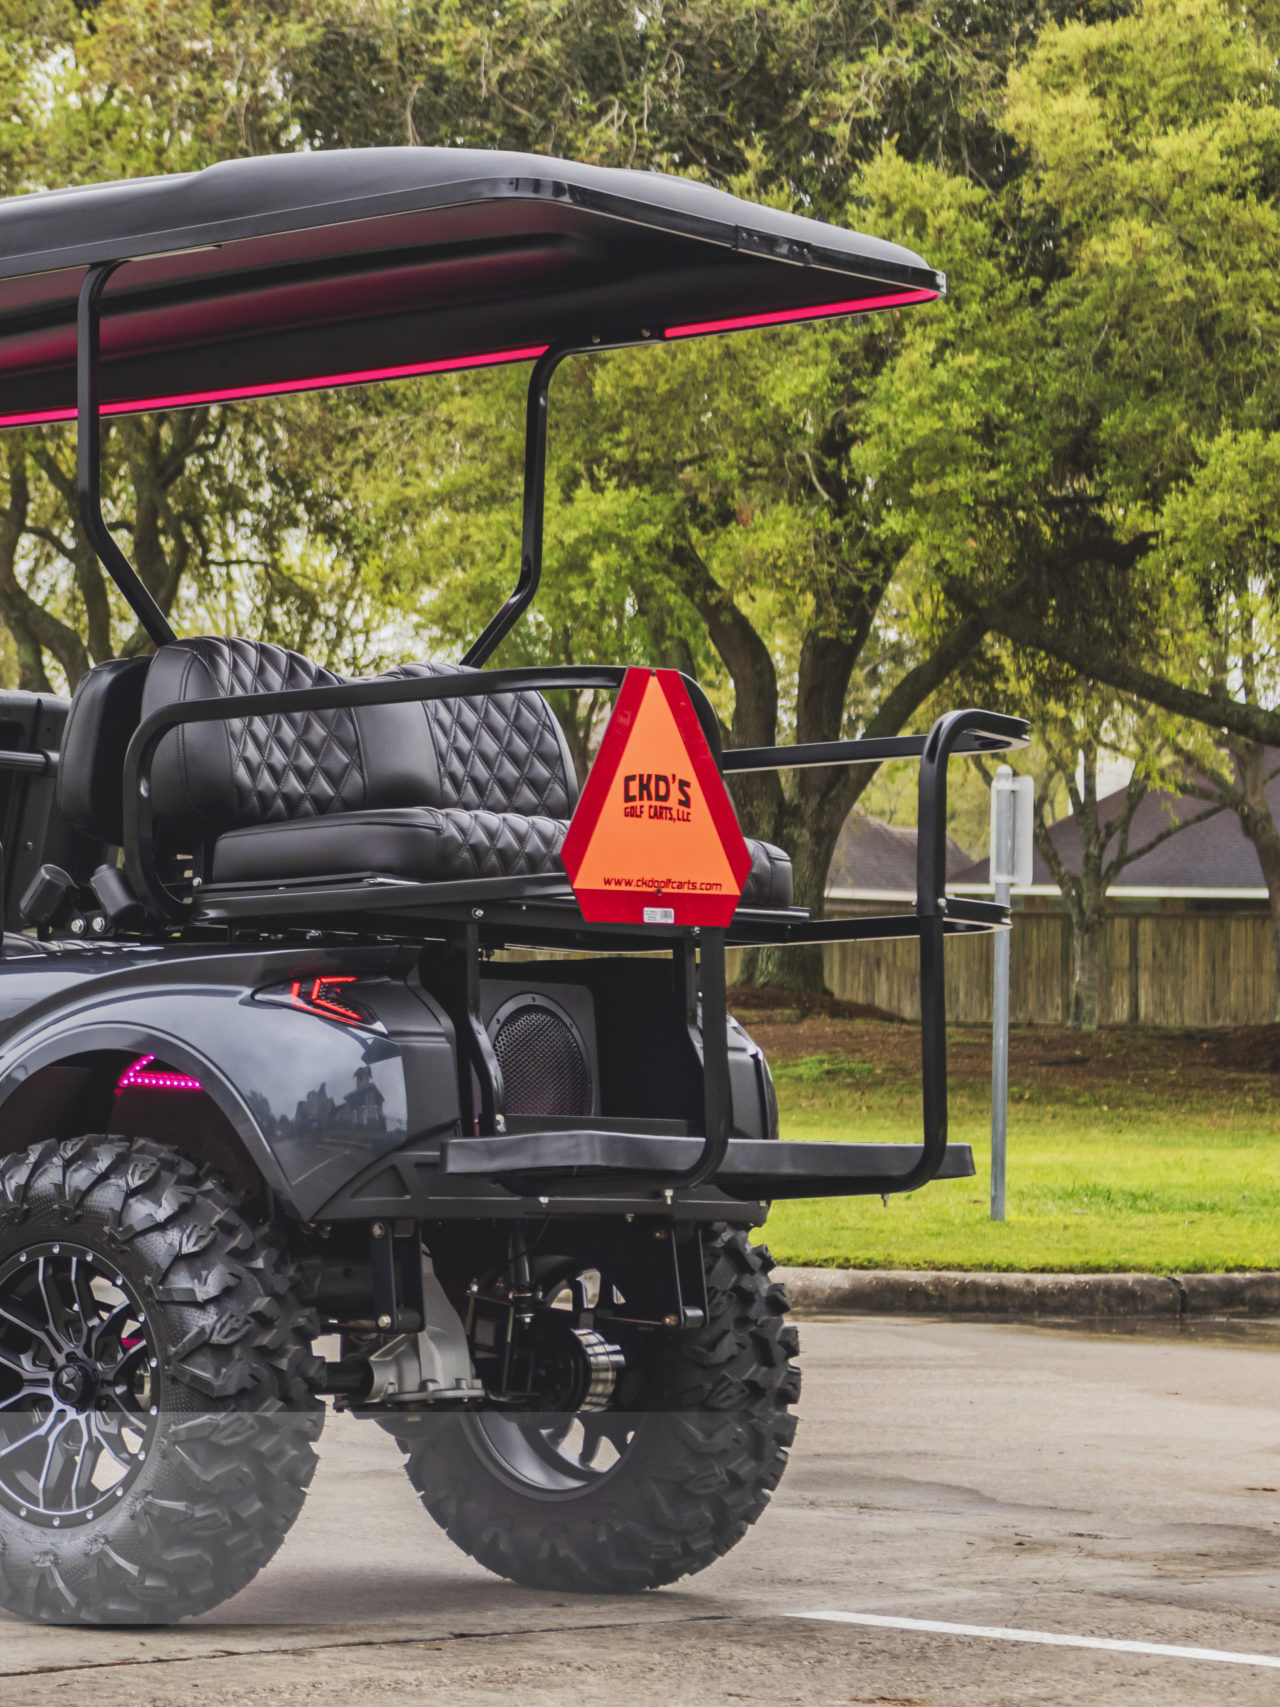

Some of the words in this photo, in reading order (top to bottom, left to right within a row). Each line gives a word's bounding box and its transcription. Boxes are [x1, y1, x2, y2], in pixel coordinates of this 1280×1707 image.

[624, 774, 691, 809] CKD'S
[624, 805, 644, 819] GOLF
[603, 877, 722, 892] www.ckdgolfcarts.com
